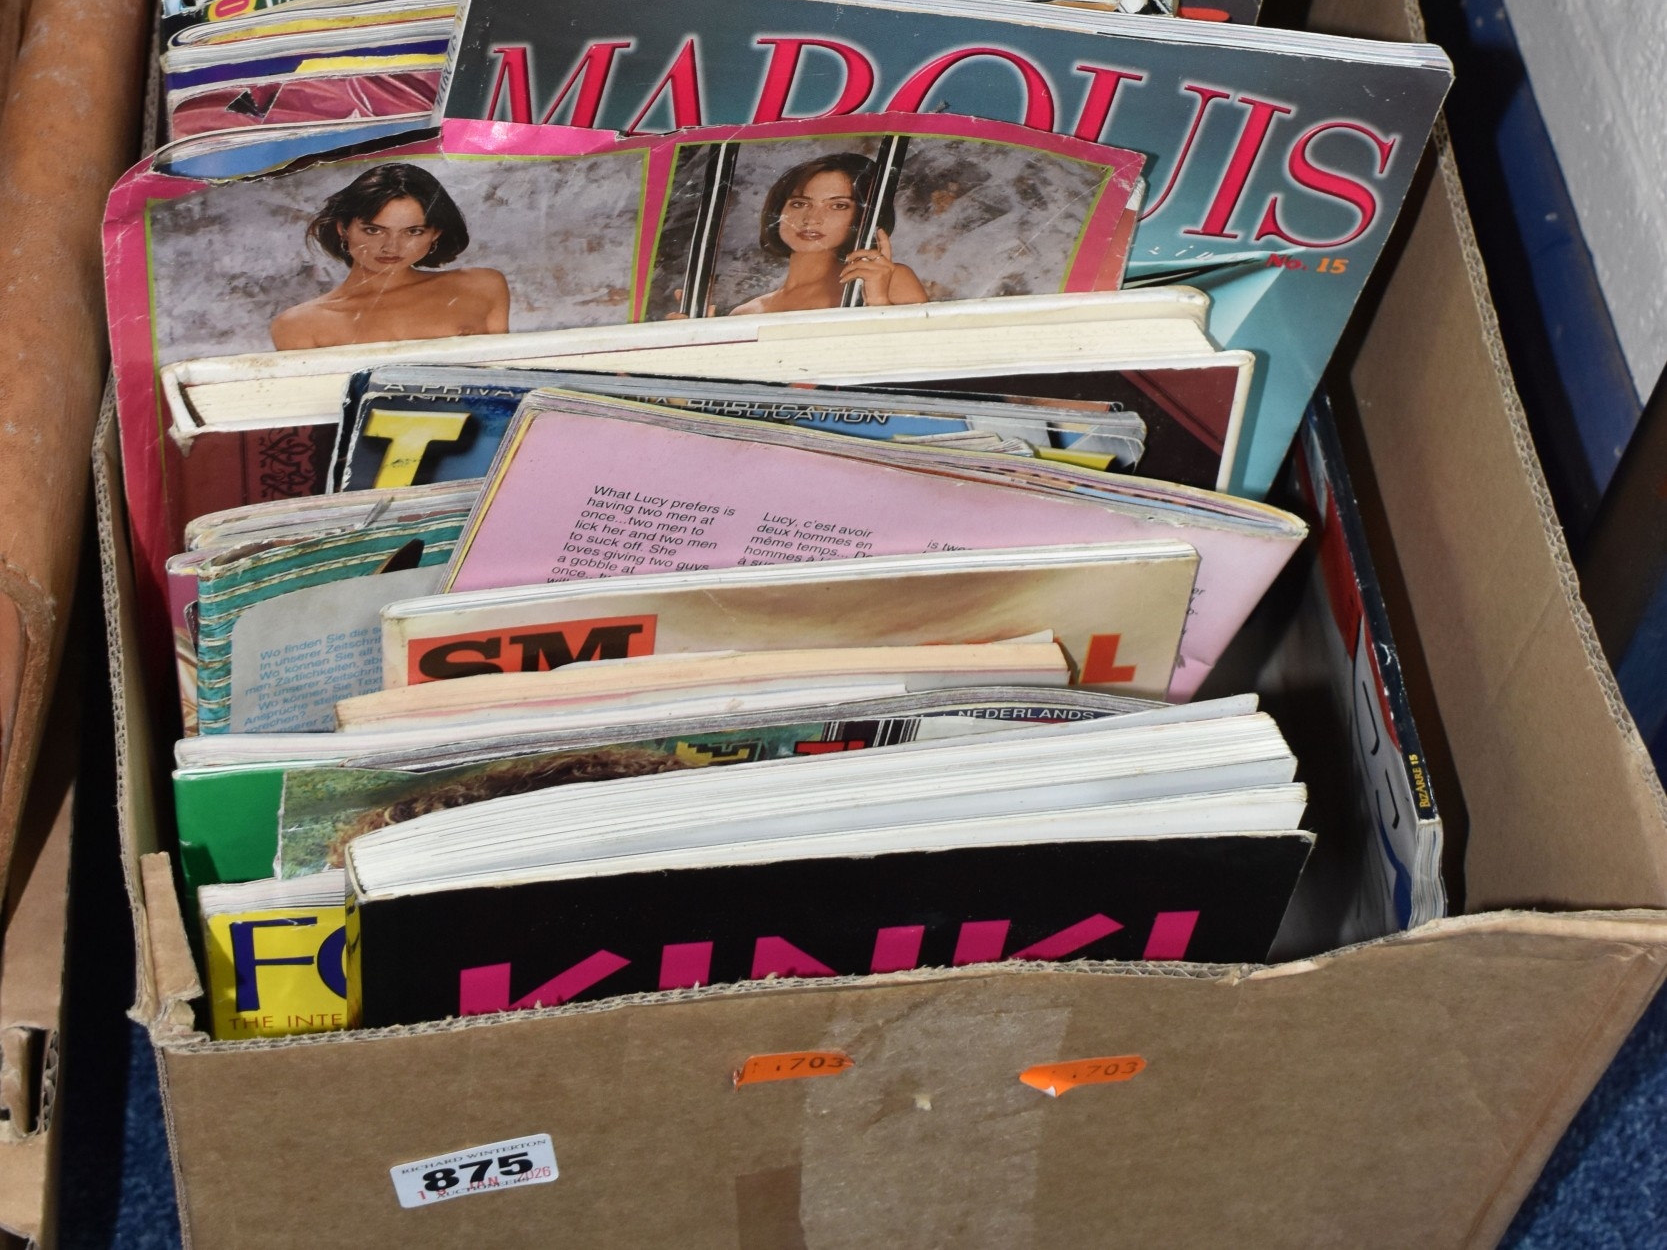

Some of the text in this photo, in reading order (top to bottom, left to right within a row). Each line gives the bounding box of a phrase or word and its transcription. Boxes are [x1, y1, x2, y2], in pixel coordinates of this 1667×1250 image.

[1265, 252, 1308, 271] No.
[1316, 257, 1349, 274] 15
[586, 497, 715, 525] having two men at
[594, 485, 736, 516] What Lucy prefers is
[575, 519, 718, 549] lick her and two men
[656, 522, 687, 533] men
[691, 527, 704, 536] to
[756, 523, 873, 550] deux hommes en
[763, 512, 874, 538] Lucy, c'est avoir
[569, 531, 677, 556] to suck off. She
[744, 545, 802, 562] hommes
[750, 535, 794, 549] même
[927, 539, 938, 550] is
[557, 555, 635, 574] a gobble at
[563, 542, 709, 571] loves giving two guys
[260, 649, 281, 661] Wo
[284, 638, 322, 654] finden
[326, 632, 346, 643] Sie
[349, 627, 368, 638] die
[418, 623, 644, 680] SM
[260, 669, 280, 681] Wo
[335, 651, 354, 662] Sie
[275, 650, 321, 667] unserer
[245, 682, 271, 697] men
[258, 700, 278, 711] Wo
[333, 682, 352, 693] Sie
[273, 681, 320, 697] unserer
[958, 707, 1095, 721] NEDERLANDS
[1408, 753, 1431, 808] BIZARRE 15
[229, 1015, 274, 1031] THE
[401, 1138, 548, 1175] RICHARD WINTERTON
[422, 1152, 534, 1192] 875
